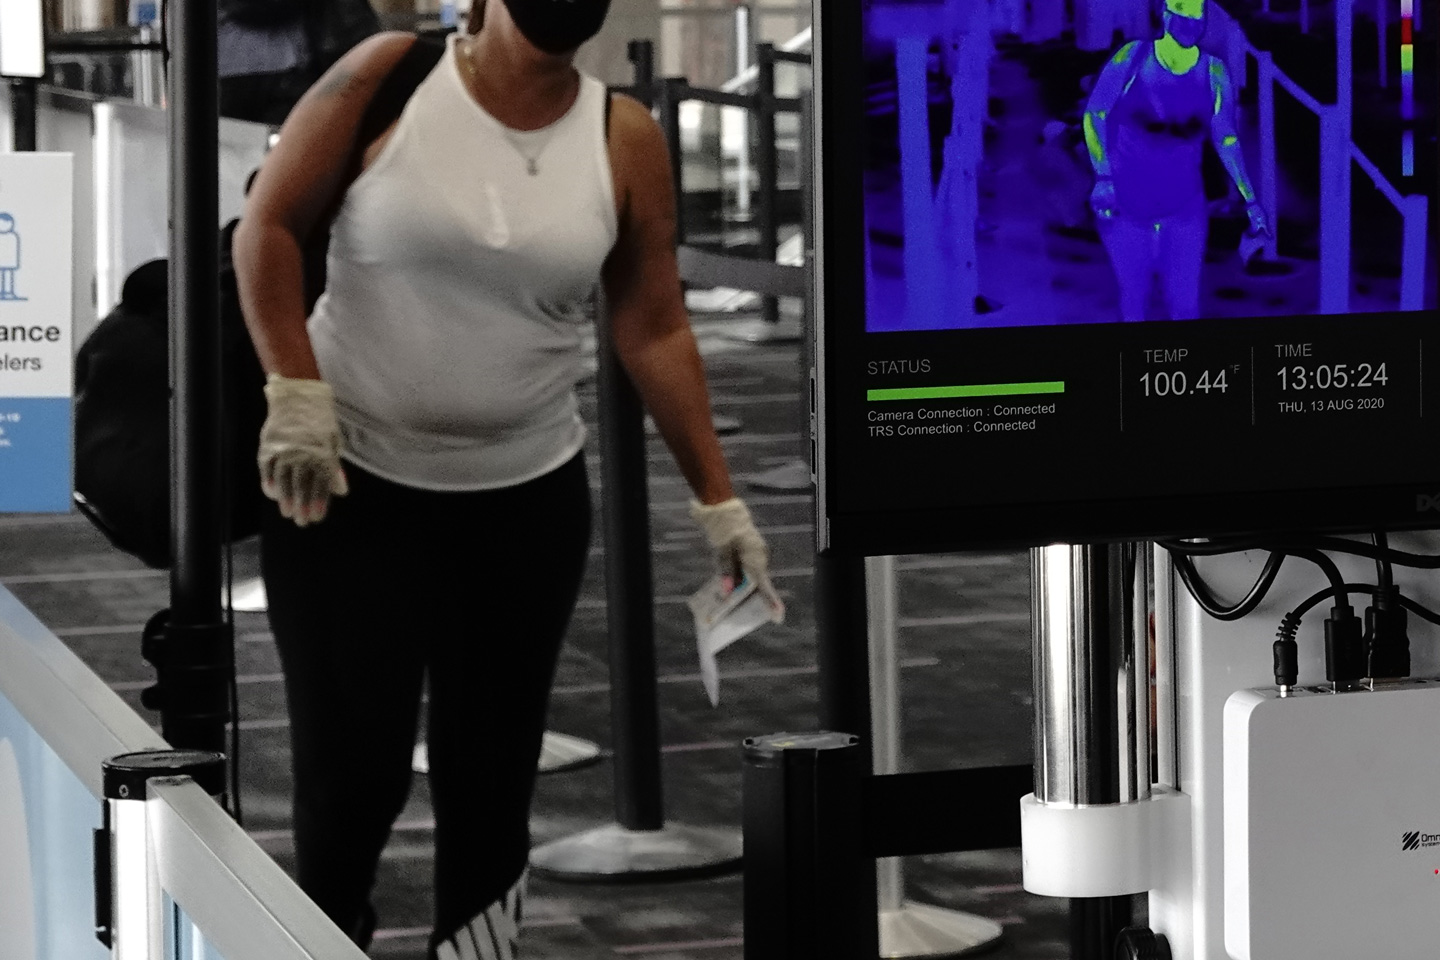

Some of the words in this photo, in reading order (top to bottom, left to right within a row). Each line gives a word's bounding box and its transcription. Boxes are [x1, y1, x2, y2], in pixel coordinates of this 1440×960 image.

[1143, 348, 1189, 364] TEMP
[1274, 343, 1313, 358] TIME
[867, 359, 931, 375] STATUS
[1139, 369, 1229, 397] 100.44
[1276, 363, 1388, 390] 13:05:24
[867, 410, 914, 422] Camera
[917, 406, 983, 420] Connection
[993, 403, 1056, 417] Connected
[1278, 401, 1308, 413] THU,
[1311, 401, 1325, 411] 13
[1327, 399, 1355, 411] AUG
[1357, 397, 1385, 409] 2020
[868, 426, 894, 437] TRS
[897, 422, 963, 436] Connection
[973, 419, 1036, 433] Connected
